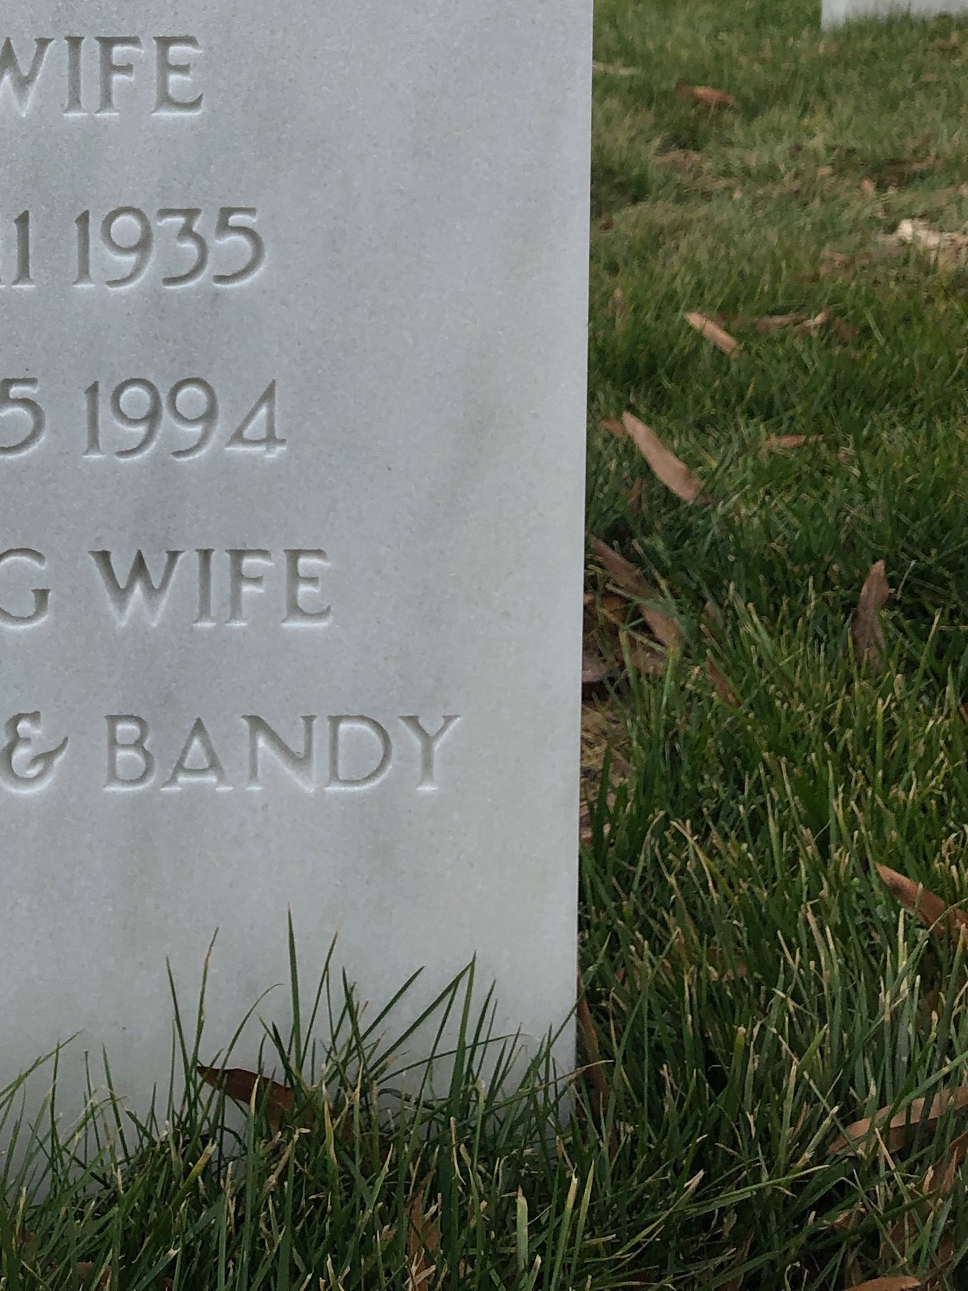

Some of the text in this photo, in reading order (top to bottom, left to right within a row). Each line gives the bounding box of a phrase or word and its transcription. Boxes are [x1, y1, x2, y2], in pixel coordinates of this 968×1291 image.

[72, 205, 266, 289] 1935
[82, 376, 288, 460] 1994
[88, 546, 334, 628] WIFE
[103, 713, 462, 791] BANDY
